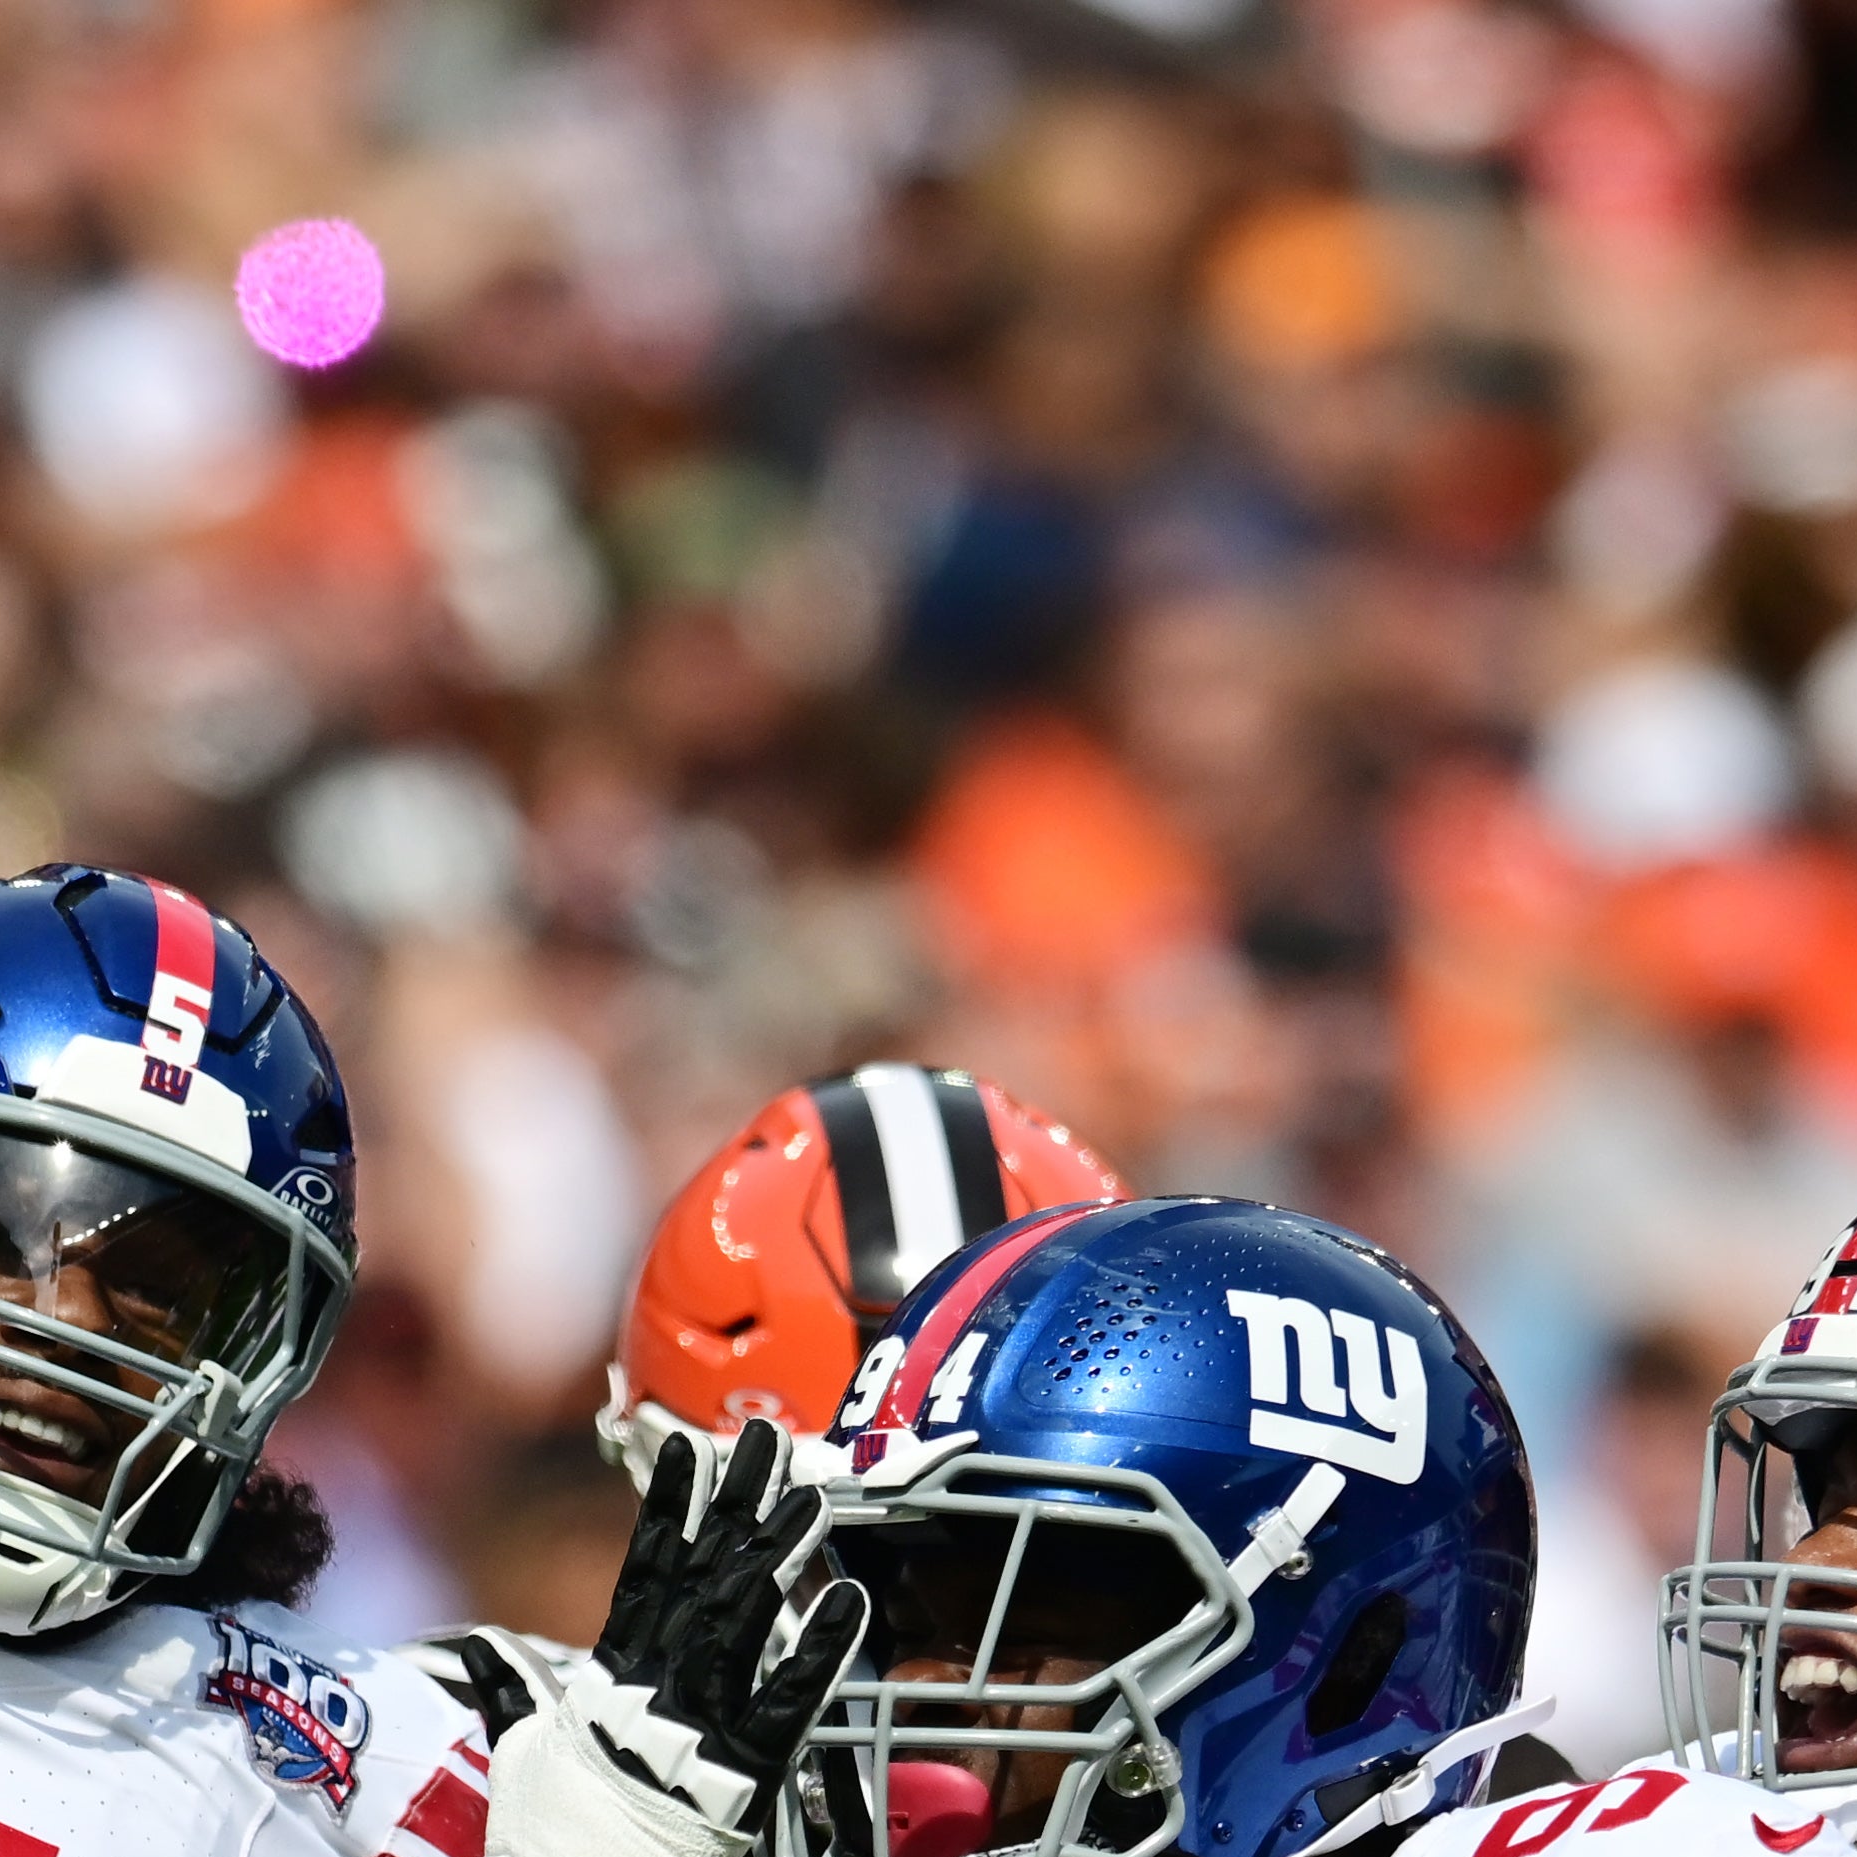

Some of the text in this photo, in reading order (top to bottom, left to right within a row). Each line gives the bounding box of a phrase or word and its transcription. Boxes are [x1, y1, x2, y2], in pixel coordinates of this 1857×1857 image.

[142, 971, 213, 1067] 5
[840, 1333, 989, 1428] 94
[208, 1622, 369, 1749] 100
[232, 1676, 345, 1764] SEASONS
